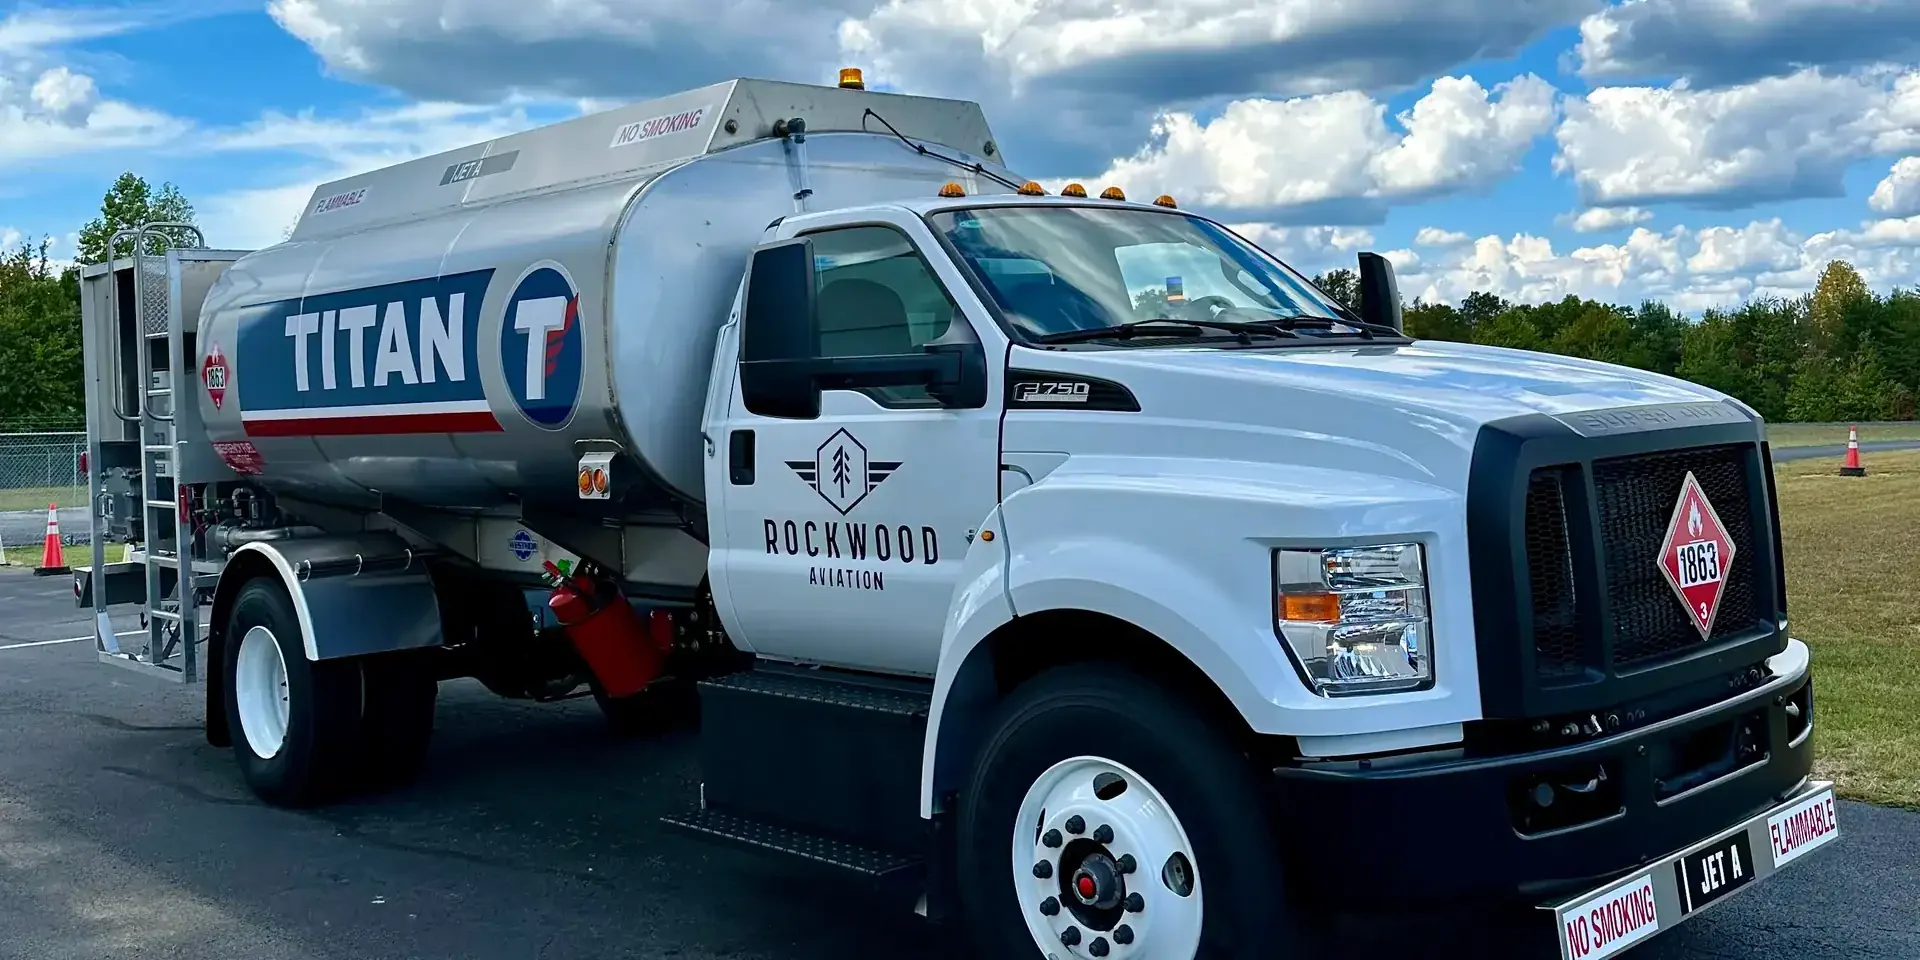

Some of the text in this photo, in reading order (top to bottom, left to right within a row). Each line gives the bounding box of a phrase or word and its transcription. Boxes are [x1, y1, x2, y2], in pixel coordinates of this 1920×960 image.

[617, 109, 703, 144] NO SMOKING
[454, 160, 483, 182] JET A
[314, 188, 367, 214] FLAMMABLE
[285, 292, 466, 392] TITAN
[207, 367, 224, 388] 1863
[764, 519, 939, 565] ROCKWOOD
[809, 567, 884, 591] AVIATION
[1680, 543, 1718, 585] 1863
[1700, 602, 1708, 619] 3
[1771, 798, 1836, 859] FLAMMABLE
[1701, 844, 1743, 895] JET A
[1567, 884, 1656, 960] NO SMOKING
